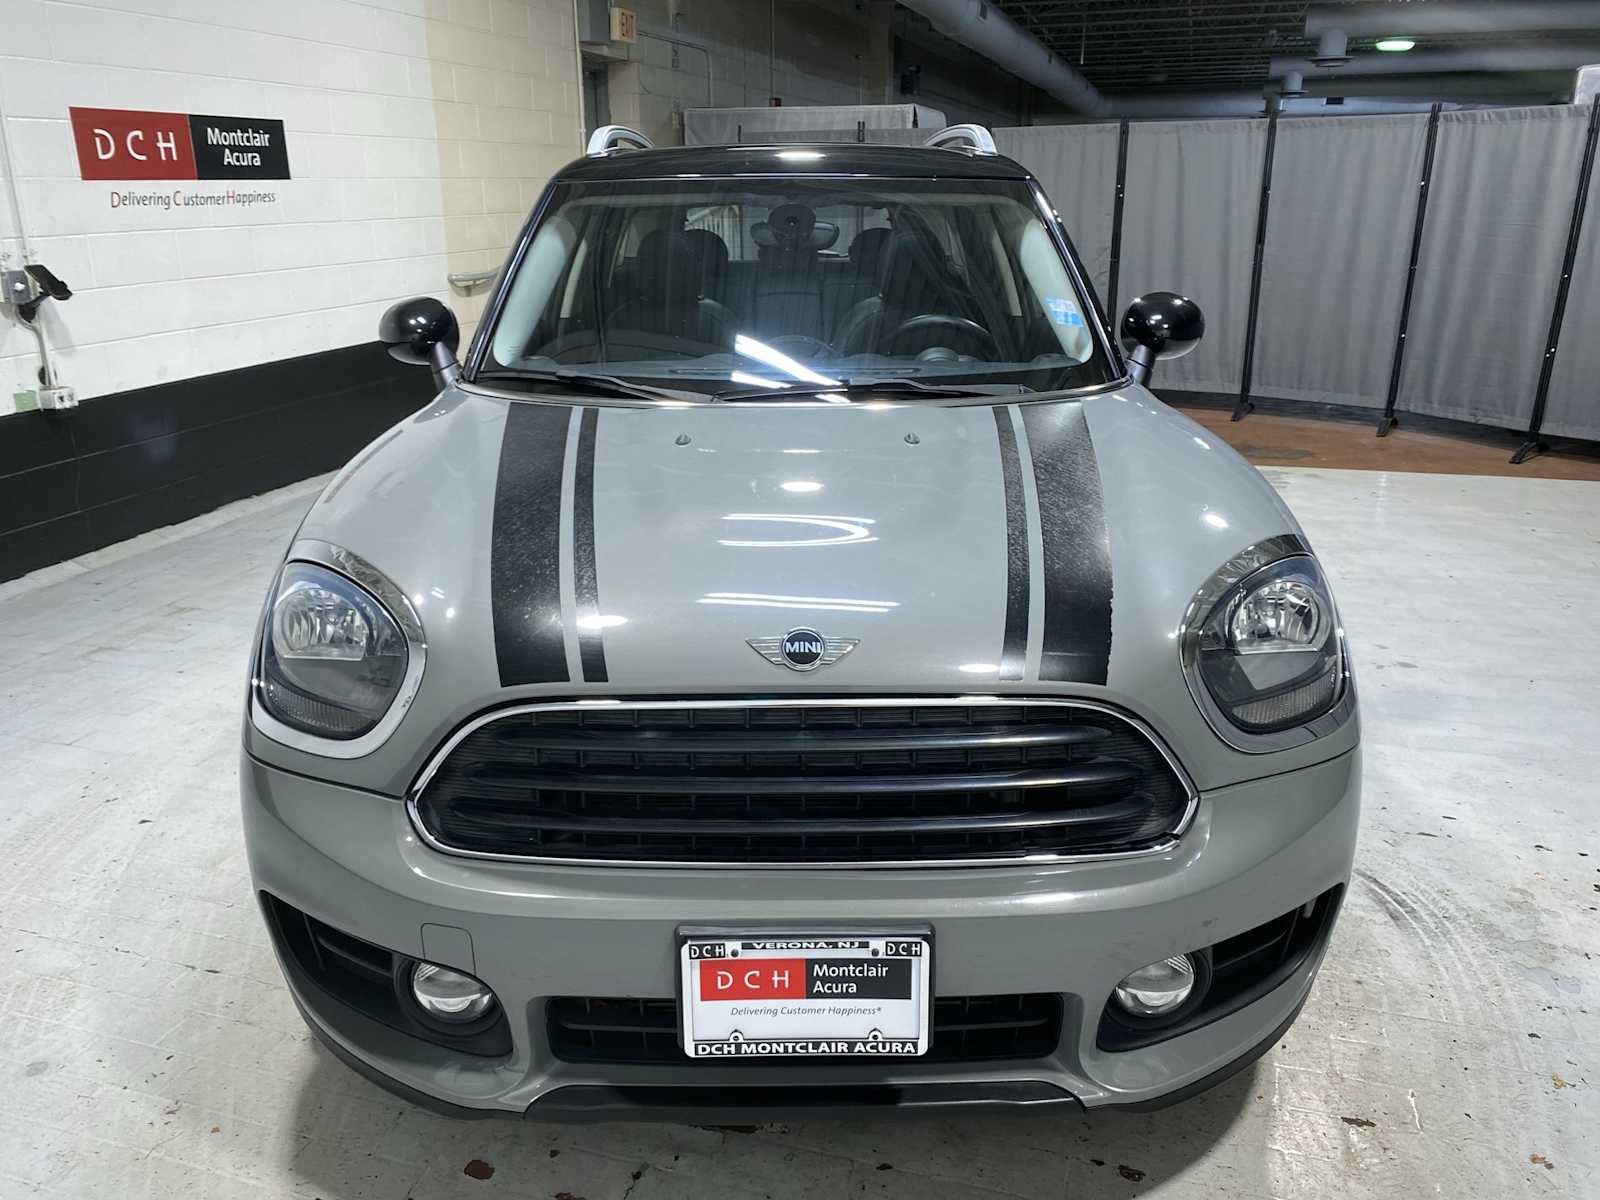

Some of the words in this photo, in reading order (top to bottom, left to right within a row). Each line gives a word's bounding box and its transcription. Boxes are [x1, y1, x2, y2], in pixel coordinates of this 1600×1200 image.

[207, 127, 270, 147] Montclair
[223, 149, 261, 166] Acura
[110, 191, 171, 210] Delivering
[173, 191, 226, 207] Customer
[226, 190, 277, 207] Happiness
[785, 641, 821, 653] MINI
[752, 941, 834, 949] VERONA,
[838, 941, 860, 949] NJ
[813, 963, 888, 978] Montclair
[812, 980, 857, 994] Acura
[730, 1006, 778, 1017] Delivering
[780, 1006, 826, 1015] Customer
[697, 1043, 736, 1055] DCH
[741, 1042, 848, 1055] MONTCLAIR
[855, 1041, 915, 1053] ACURA
